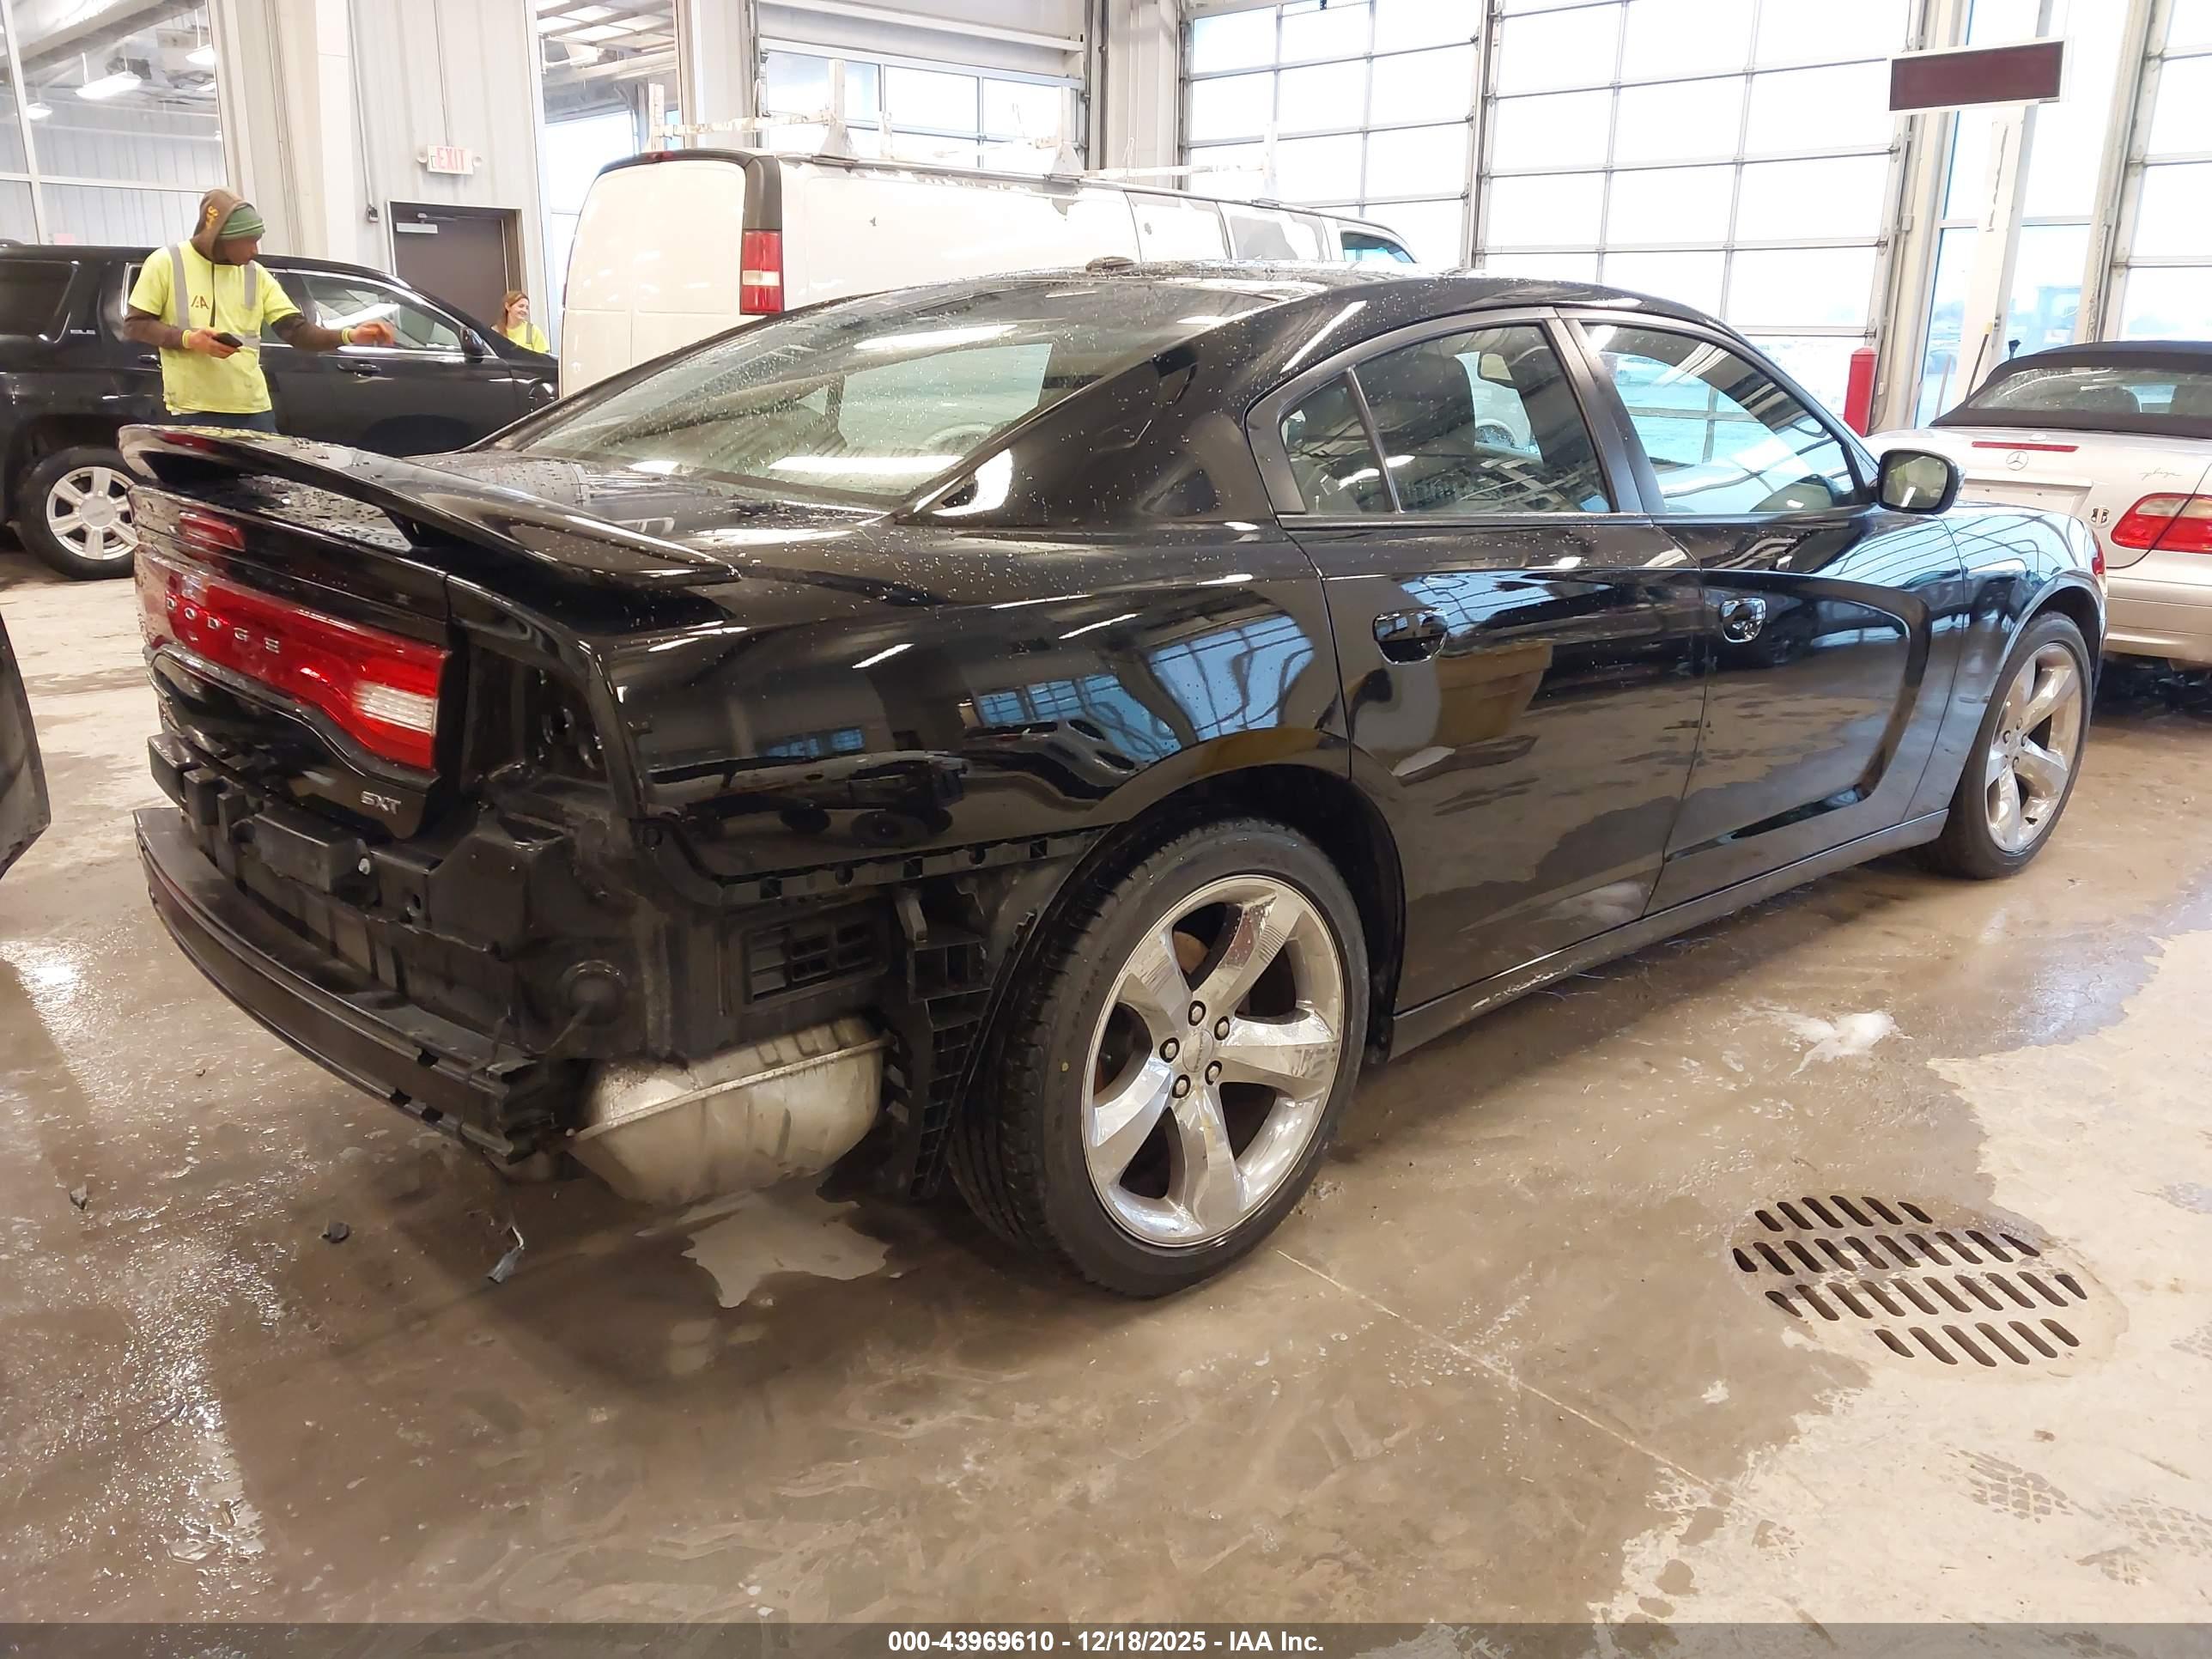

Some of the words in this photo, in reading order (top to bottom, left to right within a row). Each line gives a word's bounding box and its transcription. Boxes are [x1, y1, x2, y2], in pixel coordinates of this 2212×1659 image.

[436, 147, 466, 171] EXIT
[166, 596, 280, 654] DODGE
[361, 790, 402, 815] SXT
